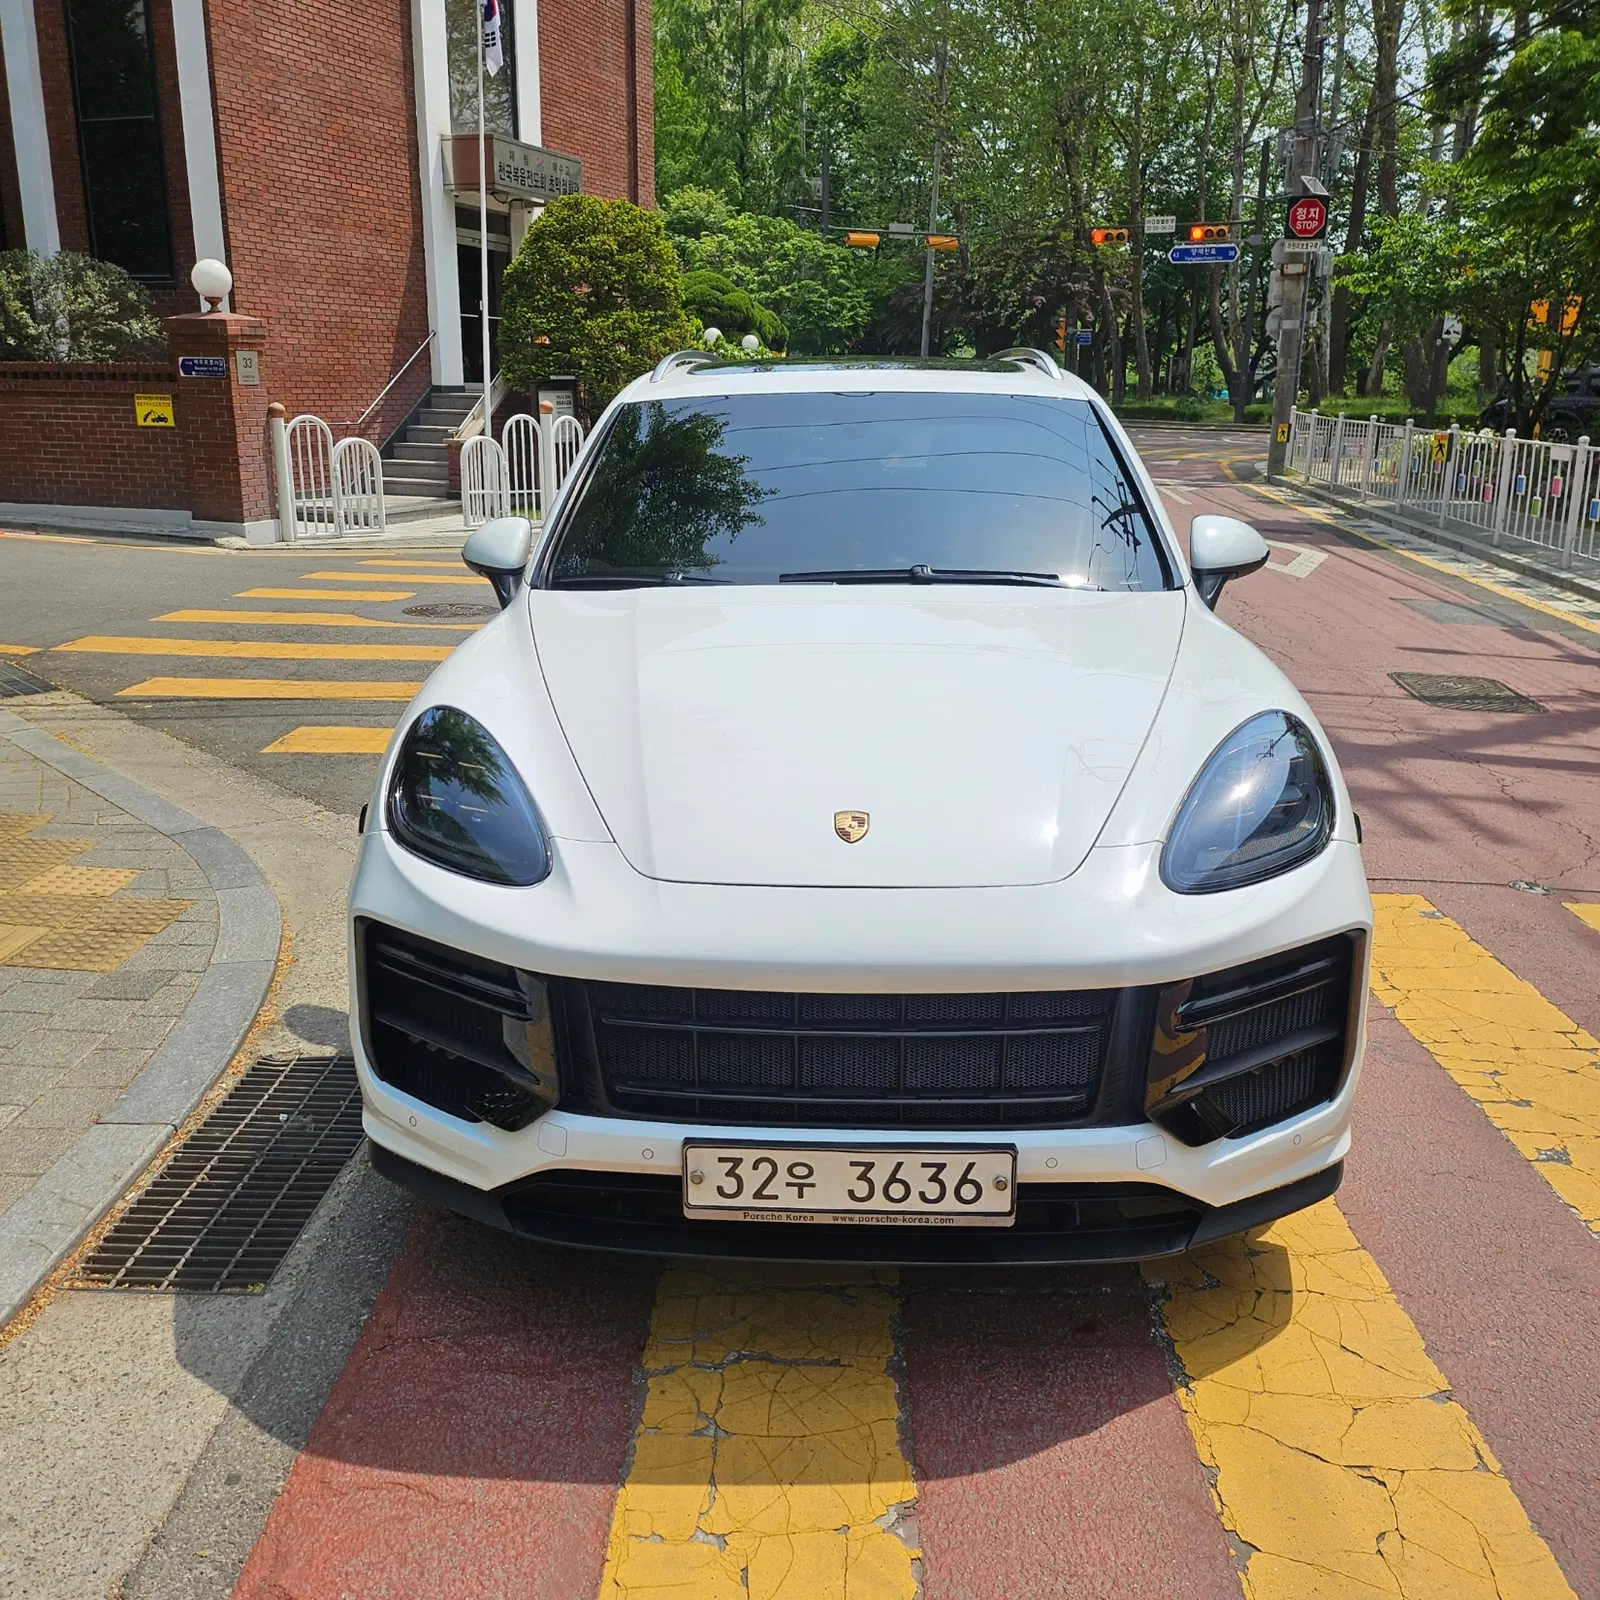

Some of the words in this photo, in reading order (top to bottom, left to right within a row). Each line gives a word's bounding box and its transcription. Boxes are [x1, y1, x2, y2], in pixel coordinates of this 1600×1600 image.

[498, 161, 546, 193] 천국복음전도회
[1296, 207, 1319, 220] 정지
[1296, 220, 1318, 230] STOP
[243, 357, 252, 368] 33
[716, 1156, 816, 1200] 32우
[847, 1161, 983, 1205] 3636
[743, 1211, 783, 1221] Porsche
[786, 1213, 815, 1222] Korea
[832, 1215, 954, 1225] www.porsche-korea.com
